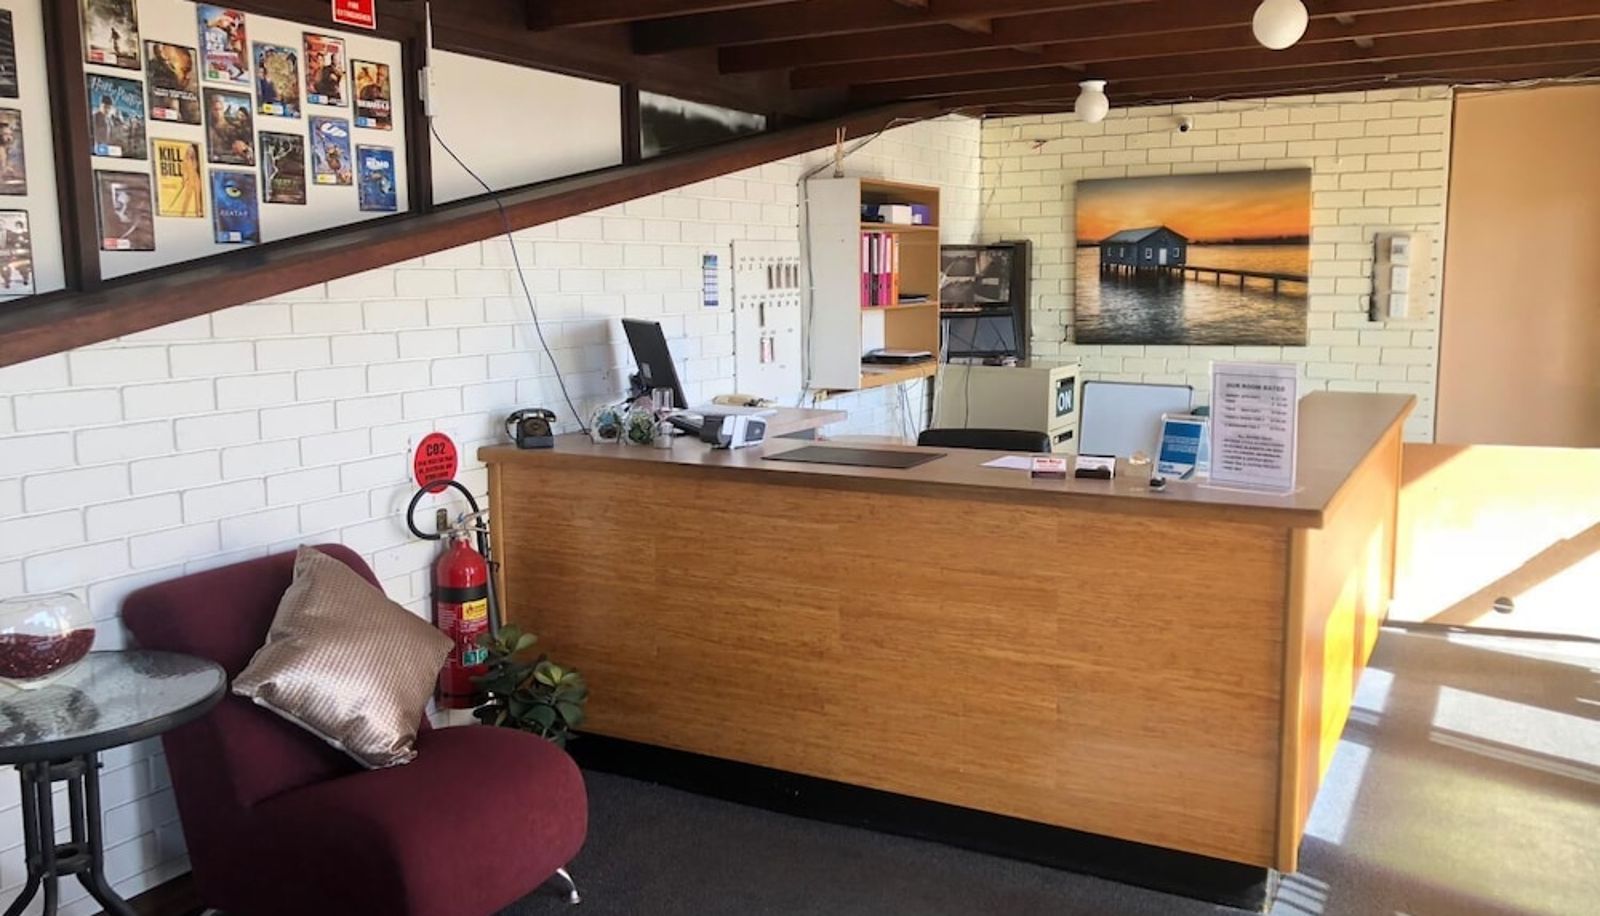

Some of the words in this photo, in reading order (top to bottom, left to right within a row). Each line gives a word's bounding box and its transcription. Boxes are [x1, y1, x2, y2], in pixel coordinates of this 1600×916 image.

[158, 147, 184, 162] KILL
[160, 162, 184, 176] BILL
[1058, 389, 1073, 411] ON
[426, 442, 446, 457] CO2
